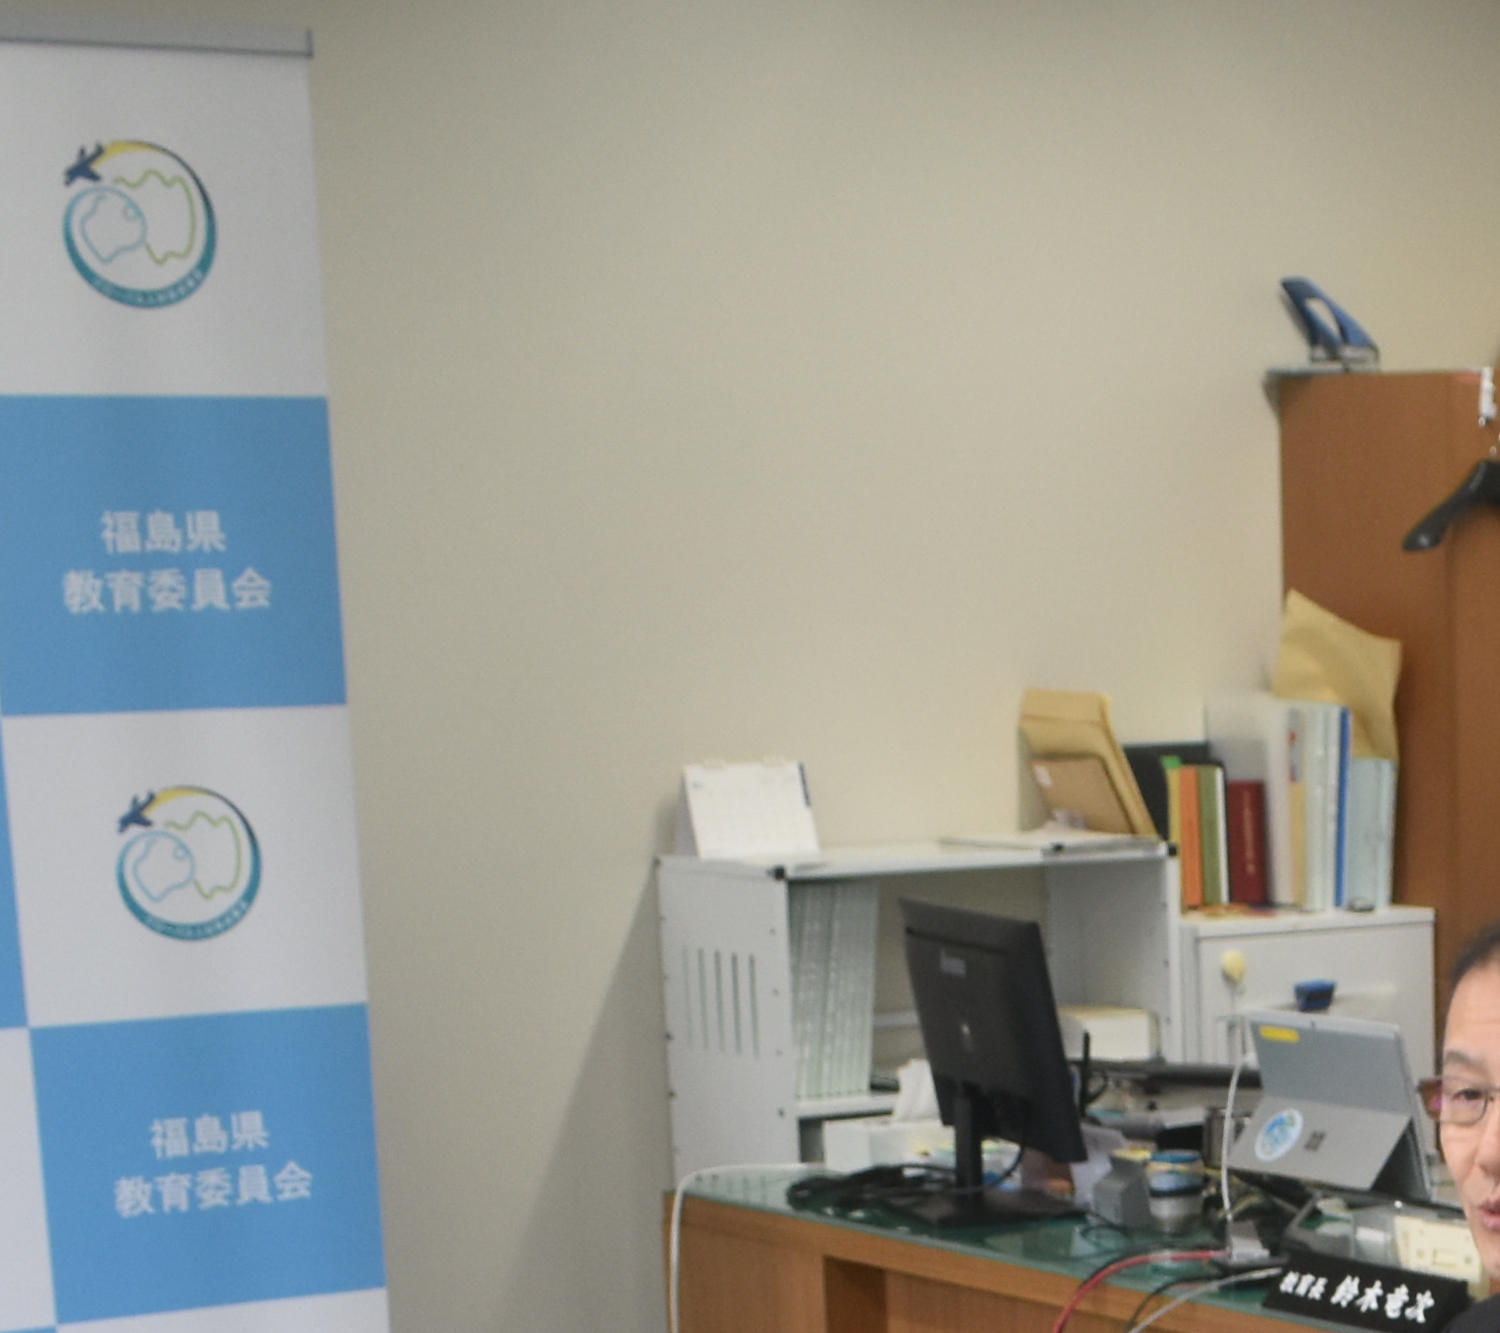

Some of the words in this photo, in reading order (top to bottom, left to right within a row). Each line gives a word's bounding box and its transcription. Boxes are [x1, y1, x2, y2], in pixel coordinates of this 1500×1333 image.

[100, 510, 226, 553] 福島県
[63, 568, 272, 613] 教育委員会
[148, 1111, 268, 1158] 福島県
[114, 1162, 313, 1218] 教育委員会
